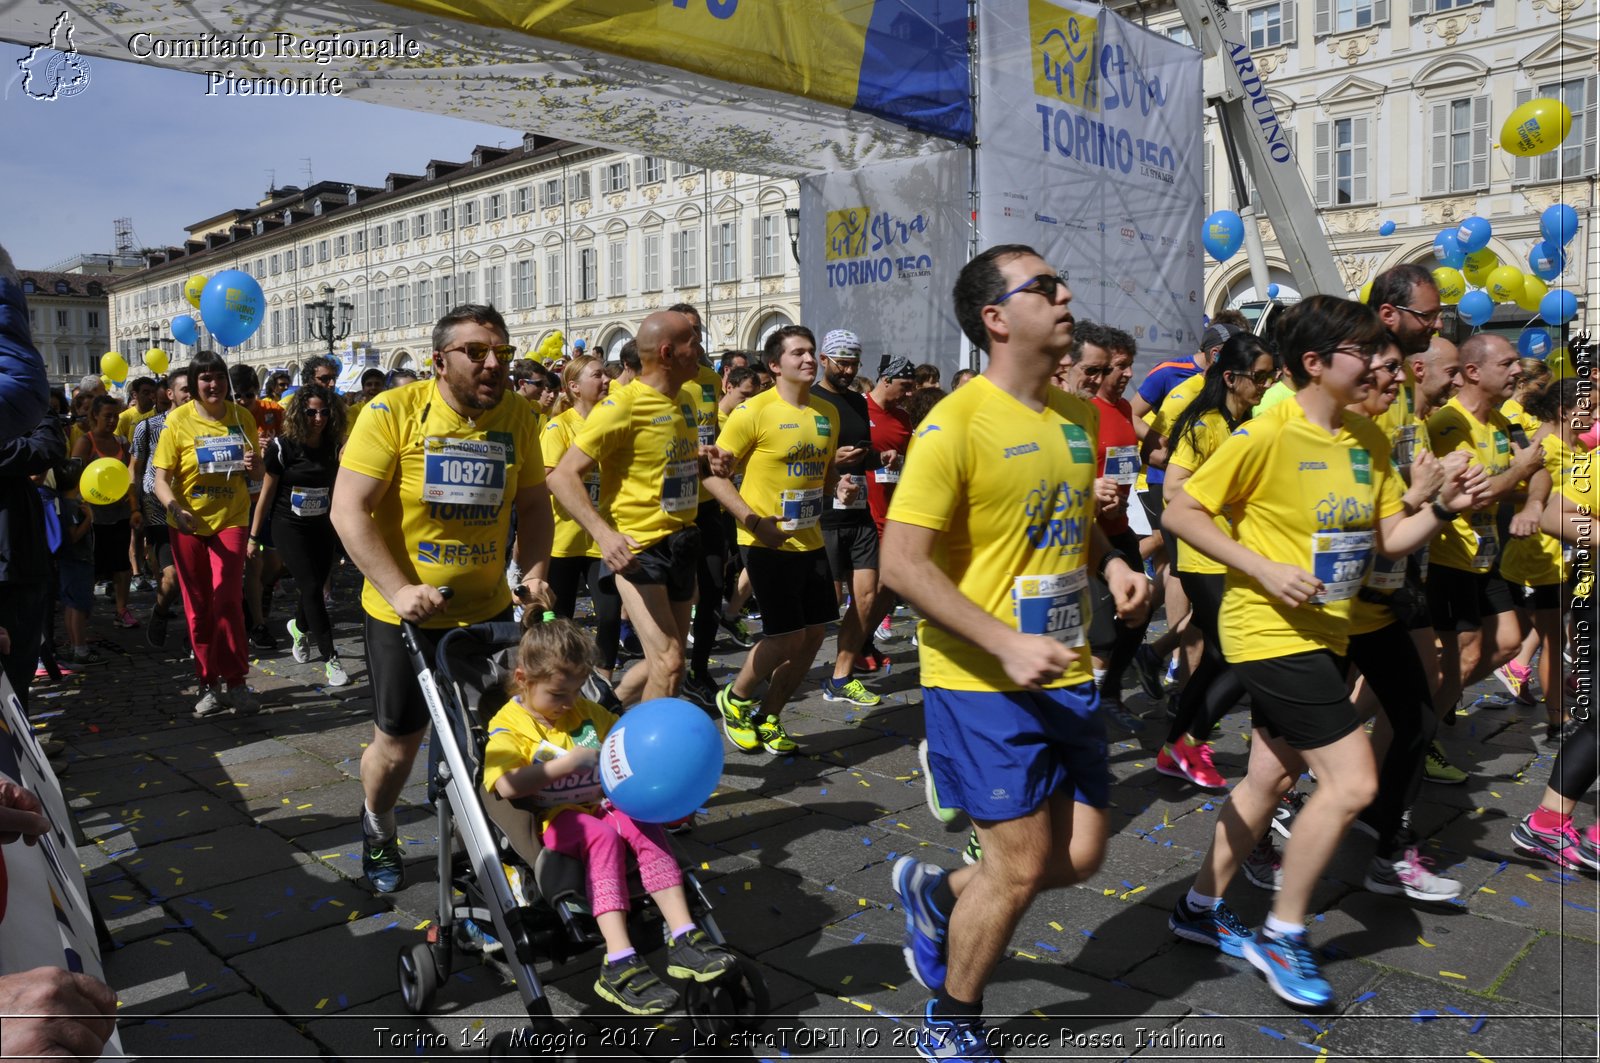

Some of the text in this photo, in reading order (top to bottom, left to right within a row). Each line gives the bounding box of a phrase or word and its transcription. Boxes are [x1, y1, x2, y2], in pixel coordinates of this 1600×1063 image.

[1211, 0, 1227, 29] CHETTI
[1043, 52, 1076, 99] 41
[1224, 40, 1290, 163] ARDUINO
[1036, 103, 1175, 174] TORINO 150
[826, 255, 932, 288] TORINO 150
[212, 450, 232, 461] 1511
[440, 459, 494, 485] 10327
[801, 504, 814, 518] 519
[444, 554, 497, 566] MUTUA
[445, 541, 497, 556] REALE
[610, 733, 629, 780] inalpi
